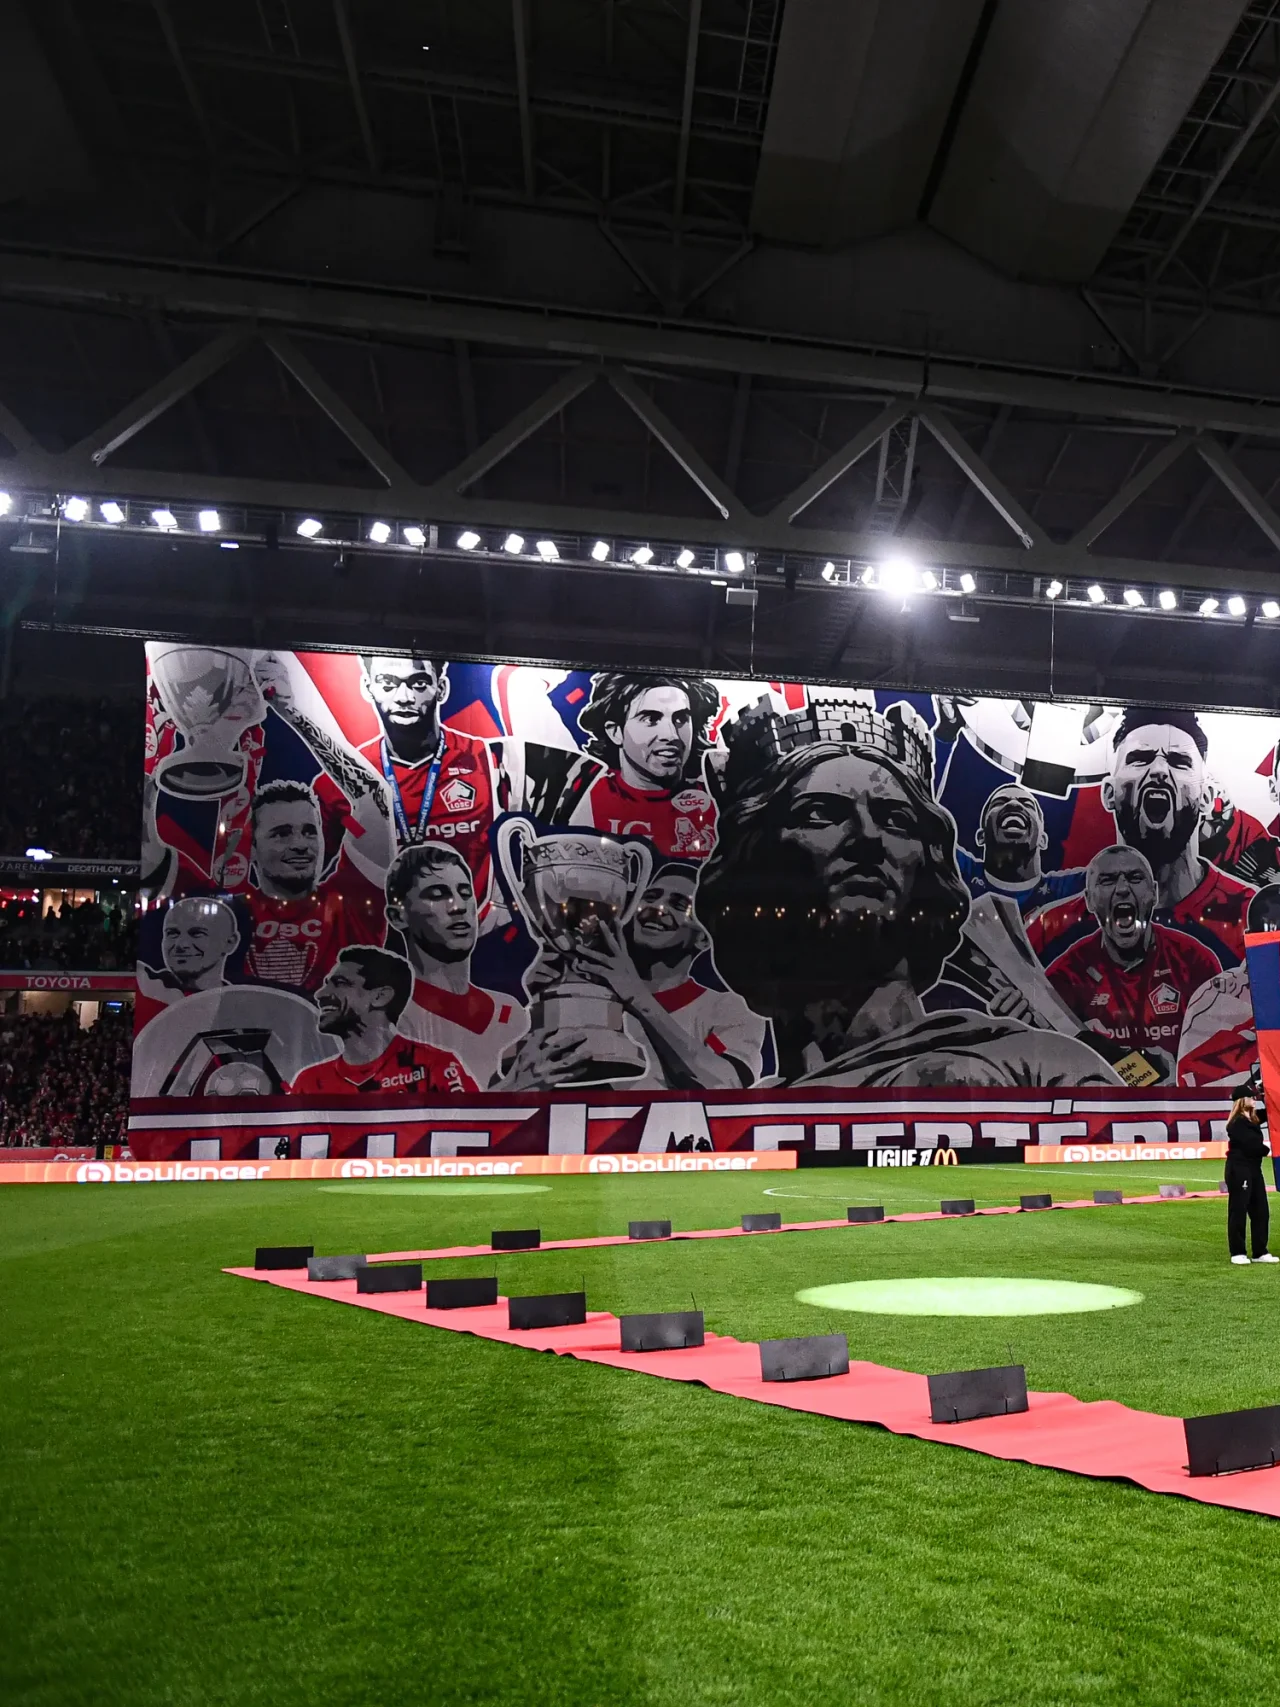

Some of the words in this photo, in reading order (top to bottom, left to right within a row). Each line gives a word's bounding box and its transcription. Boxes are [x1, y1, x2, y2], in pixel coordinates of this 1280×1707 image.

[7, 862, 45, 871] ARENA
[68, 864, 122, 873] DECATHLON
[25, 976, 91, 988] TOYOTA
[381, 1066, 425, 1088] actual
[1091, 1145, 1206, 1161] boulanger
[377, 1159, 522, 1177] boulanger
[622, 1154, 758, 1172] boulanger
[114, 1163, 270, 1181] boulanger
